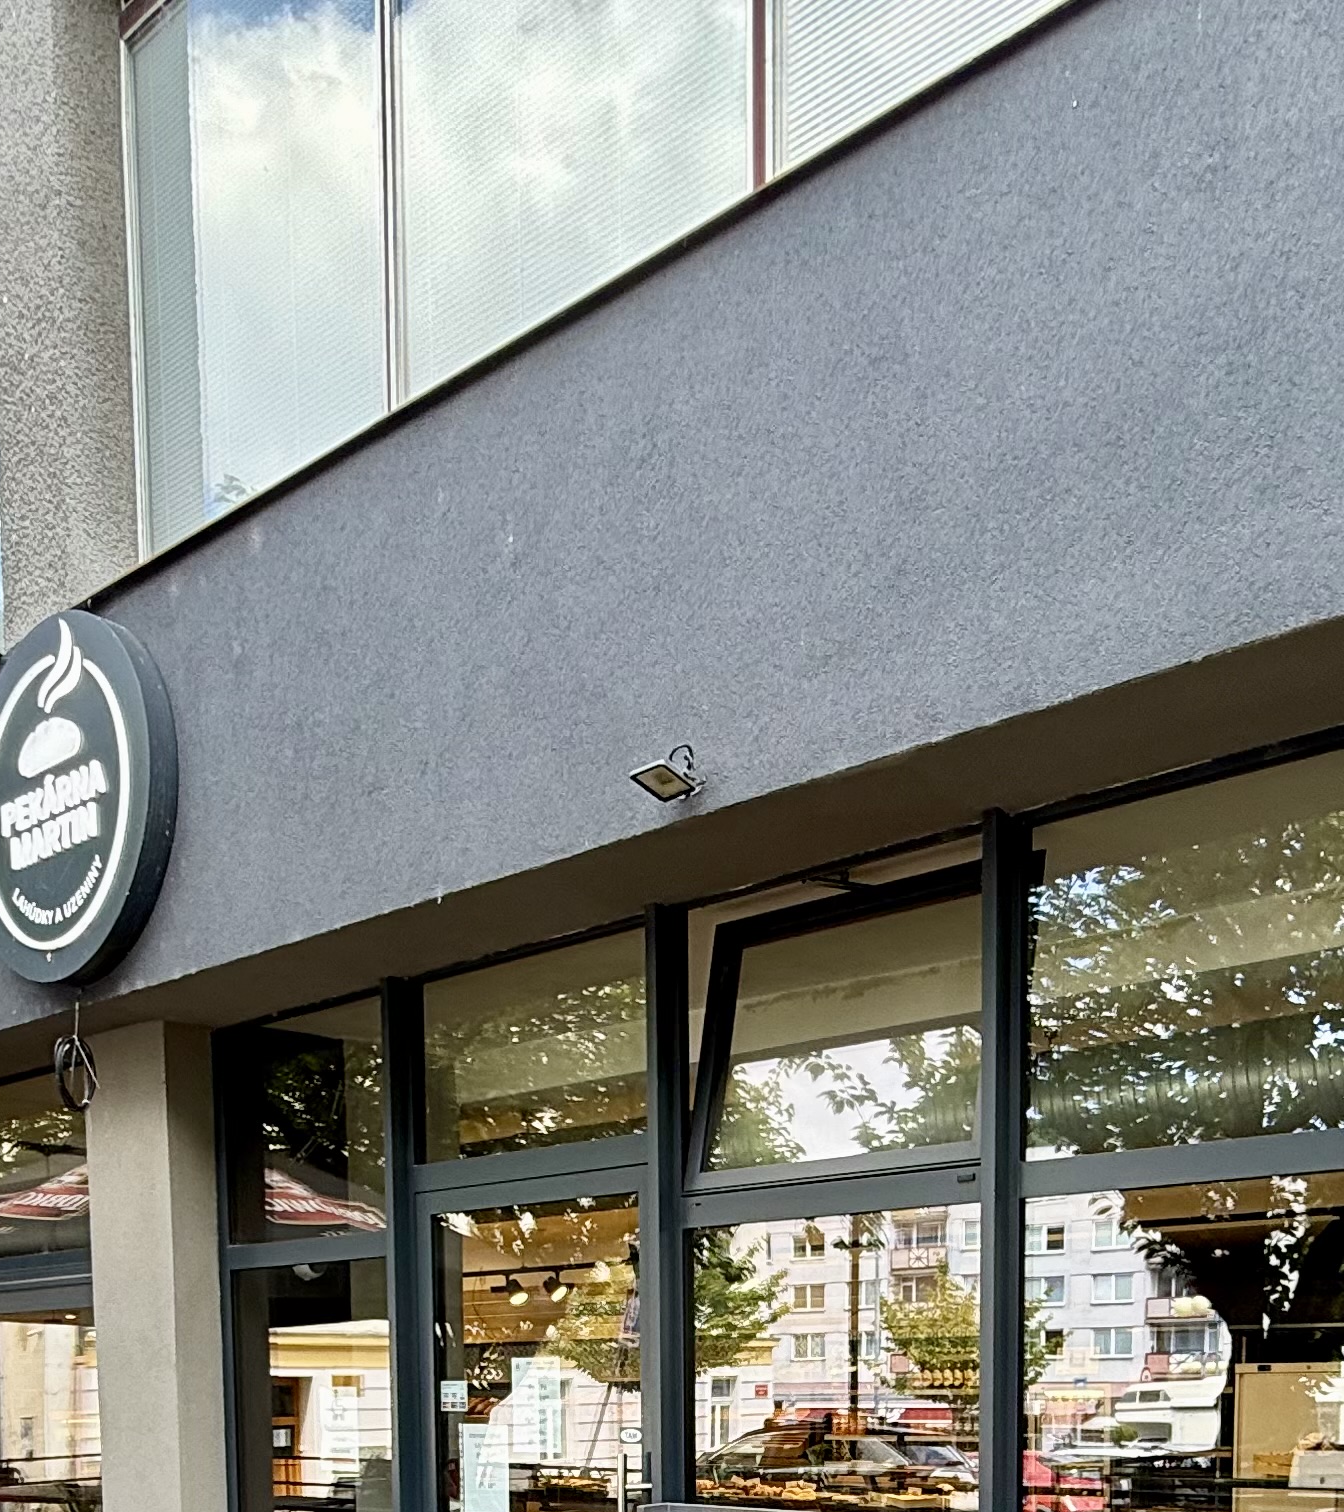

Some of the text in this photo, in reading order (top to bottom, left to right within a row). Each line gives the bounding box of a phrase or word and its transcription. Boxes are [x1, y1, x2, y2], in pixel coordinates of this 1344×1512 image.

[0, 759, 108, 838] PEKÁRNA
[10, 801, 99, 870] MARTIN
[54, 907, 63, 924] A
[63, 854, 103, 918] UZENINY
